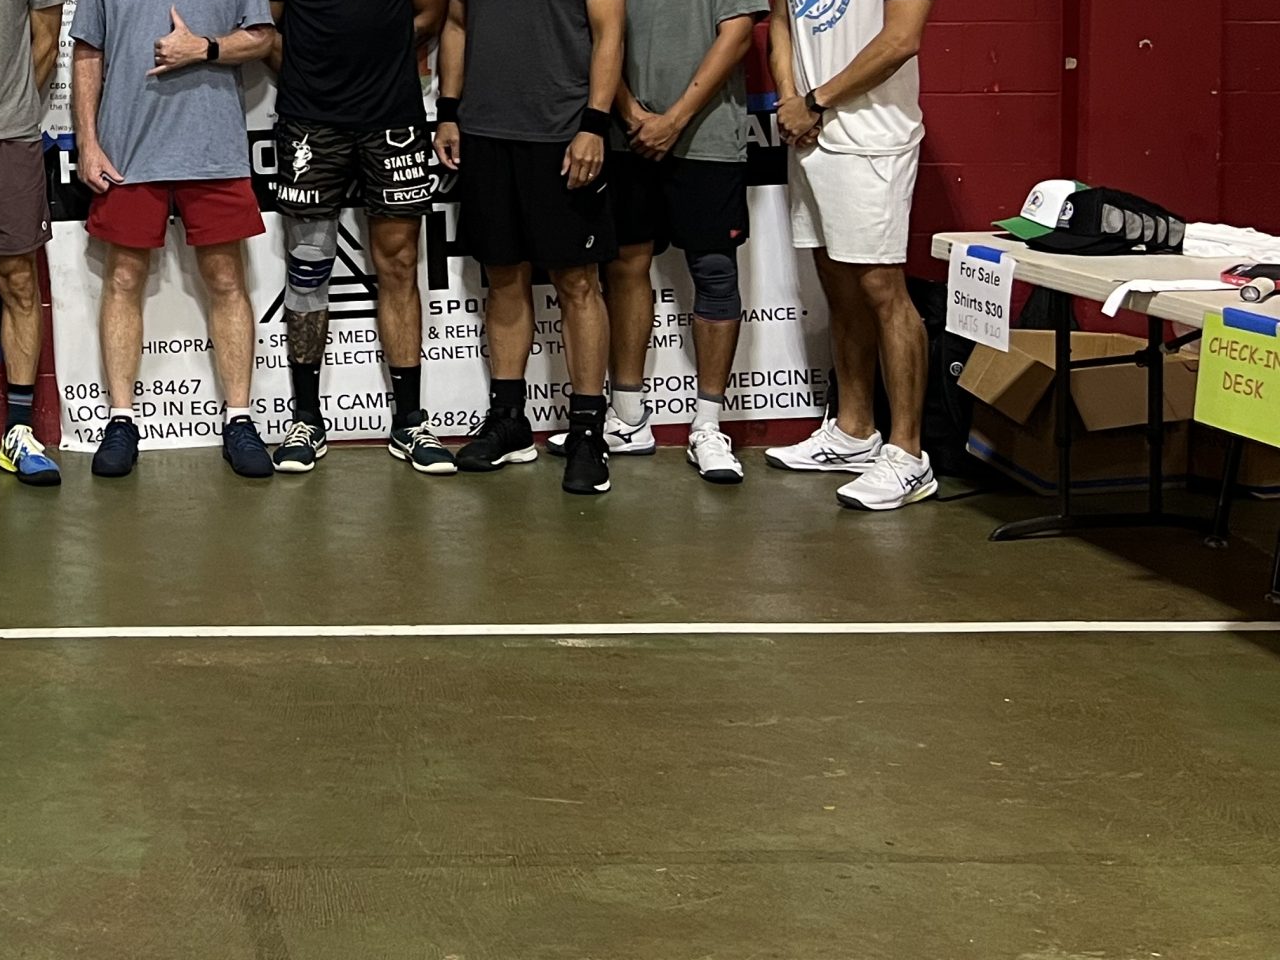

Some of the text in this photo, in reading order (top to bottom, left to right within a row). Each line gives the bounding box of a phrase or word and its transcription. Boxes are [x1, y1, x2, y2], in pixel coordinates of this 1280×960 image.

[384, 151, 426, 170] STATE OF
[393, 166, 425, 182] ALOHA
[393, 189, 429, 201] RVCA
[960, 262, 1000, 286] For Sale
[954, 290, 1003, 319] Shirts $30
[428, 326, 440, 340] &
[1209, 337, 1280, 371] CHECK-IN
[1222, 371, 1264, 400] DESK
[163, 400, 183, 416] IN
